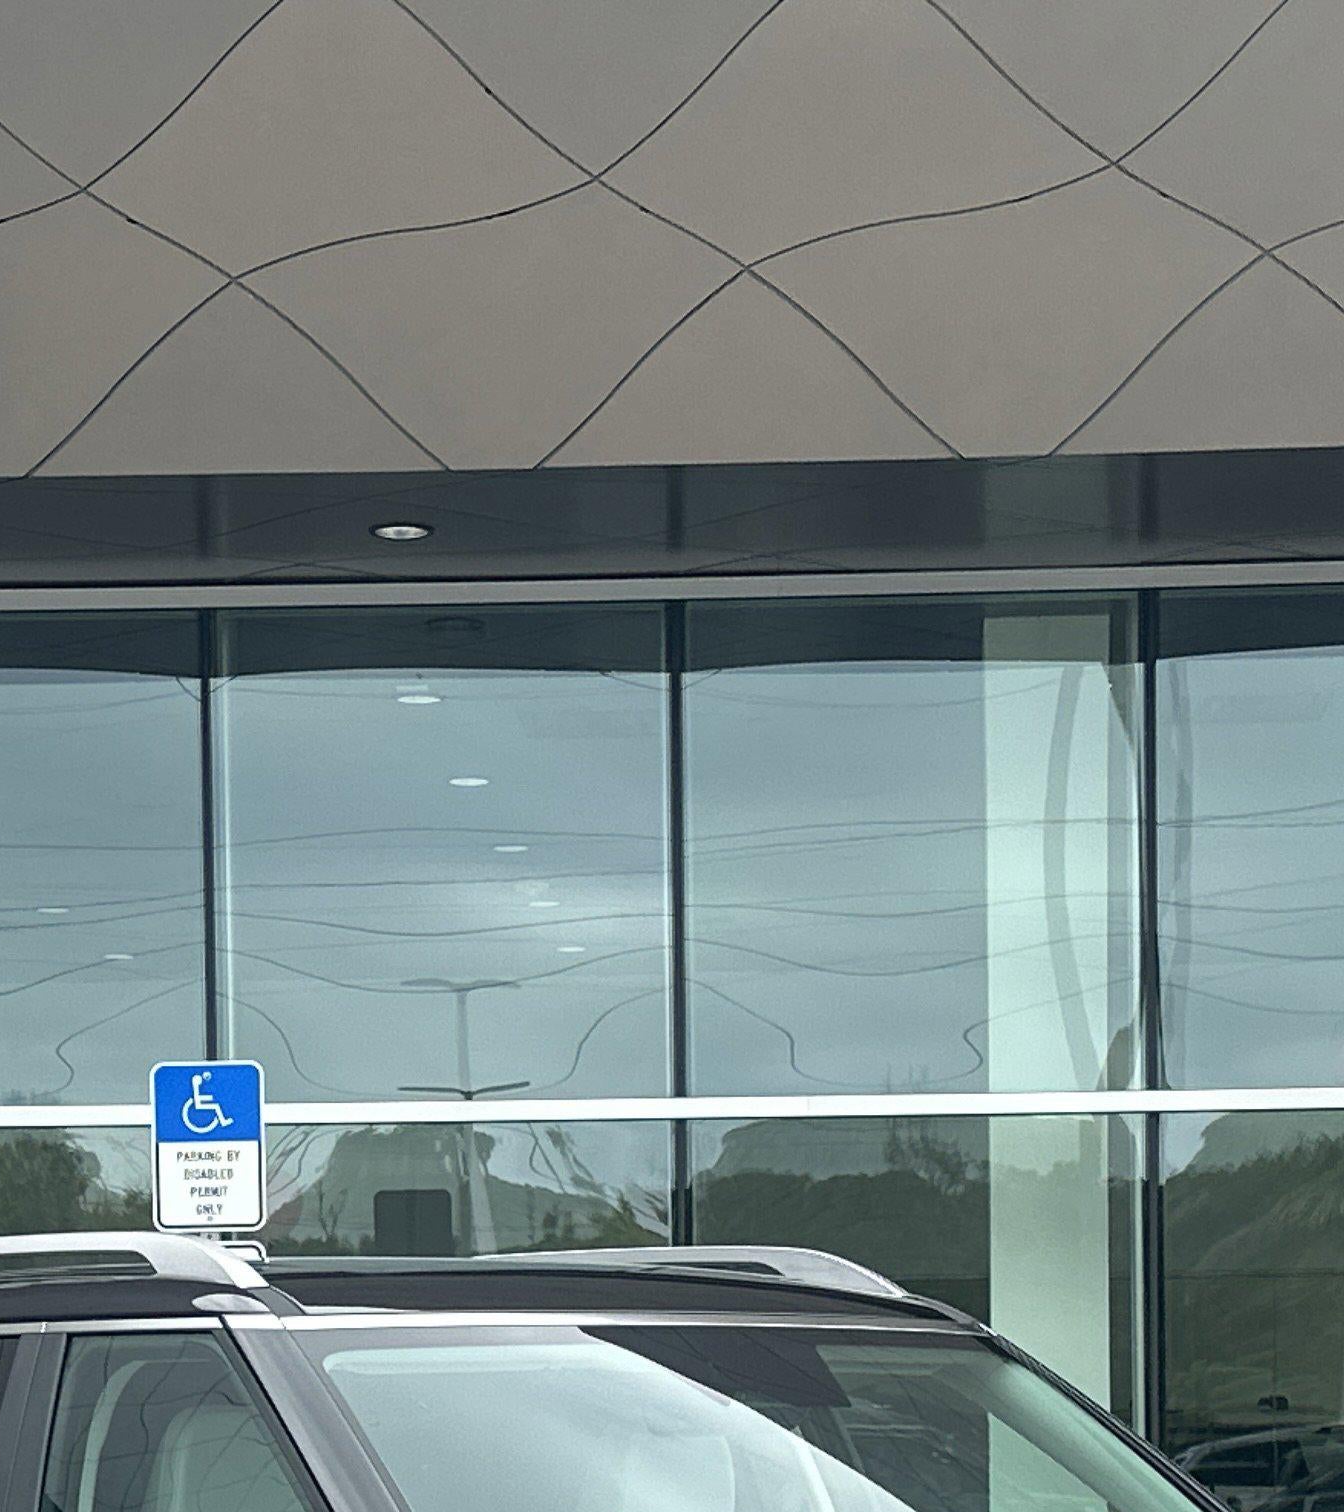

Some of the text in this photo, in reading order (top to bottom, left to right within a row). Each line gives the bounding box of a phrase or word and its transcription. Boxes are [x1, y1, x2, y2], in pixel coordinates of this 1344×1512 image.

[176, 1149, 241, 1162] PARKING BY
[184, 1168, 233, 1180] DISABLED
[190, 1187, 228, 1198] PERMIT
[196, 1204, 223, 1215] ONLY
